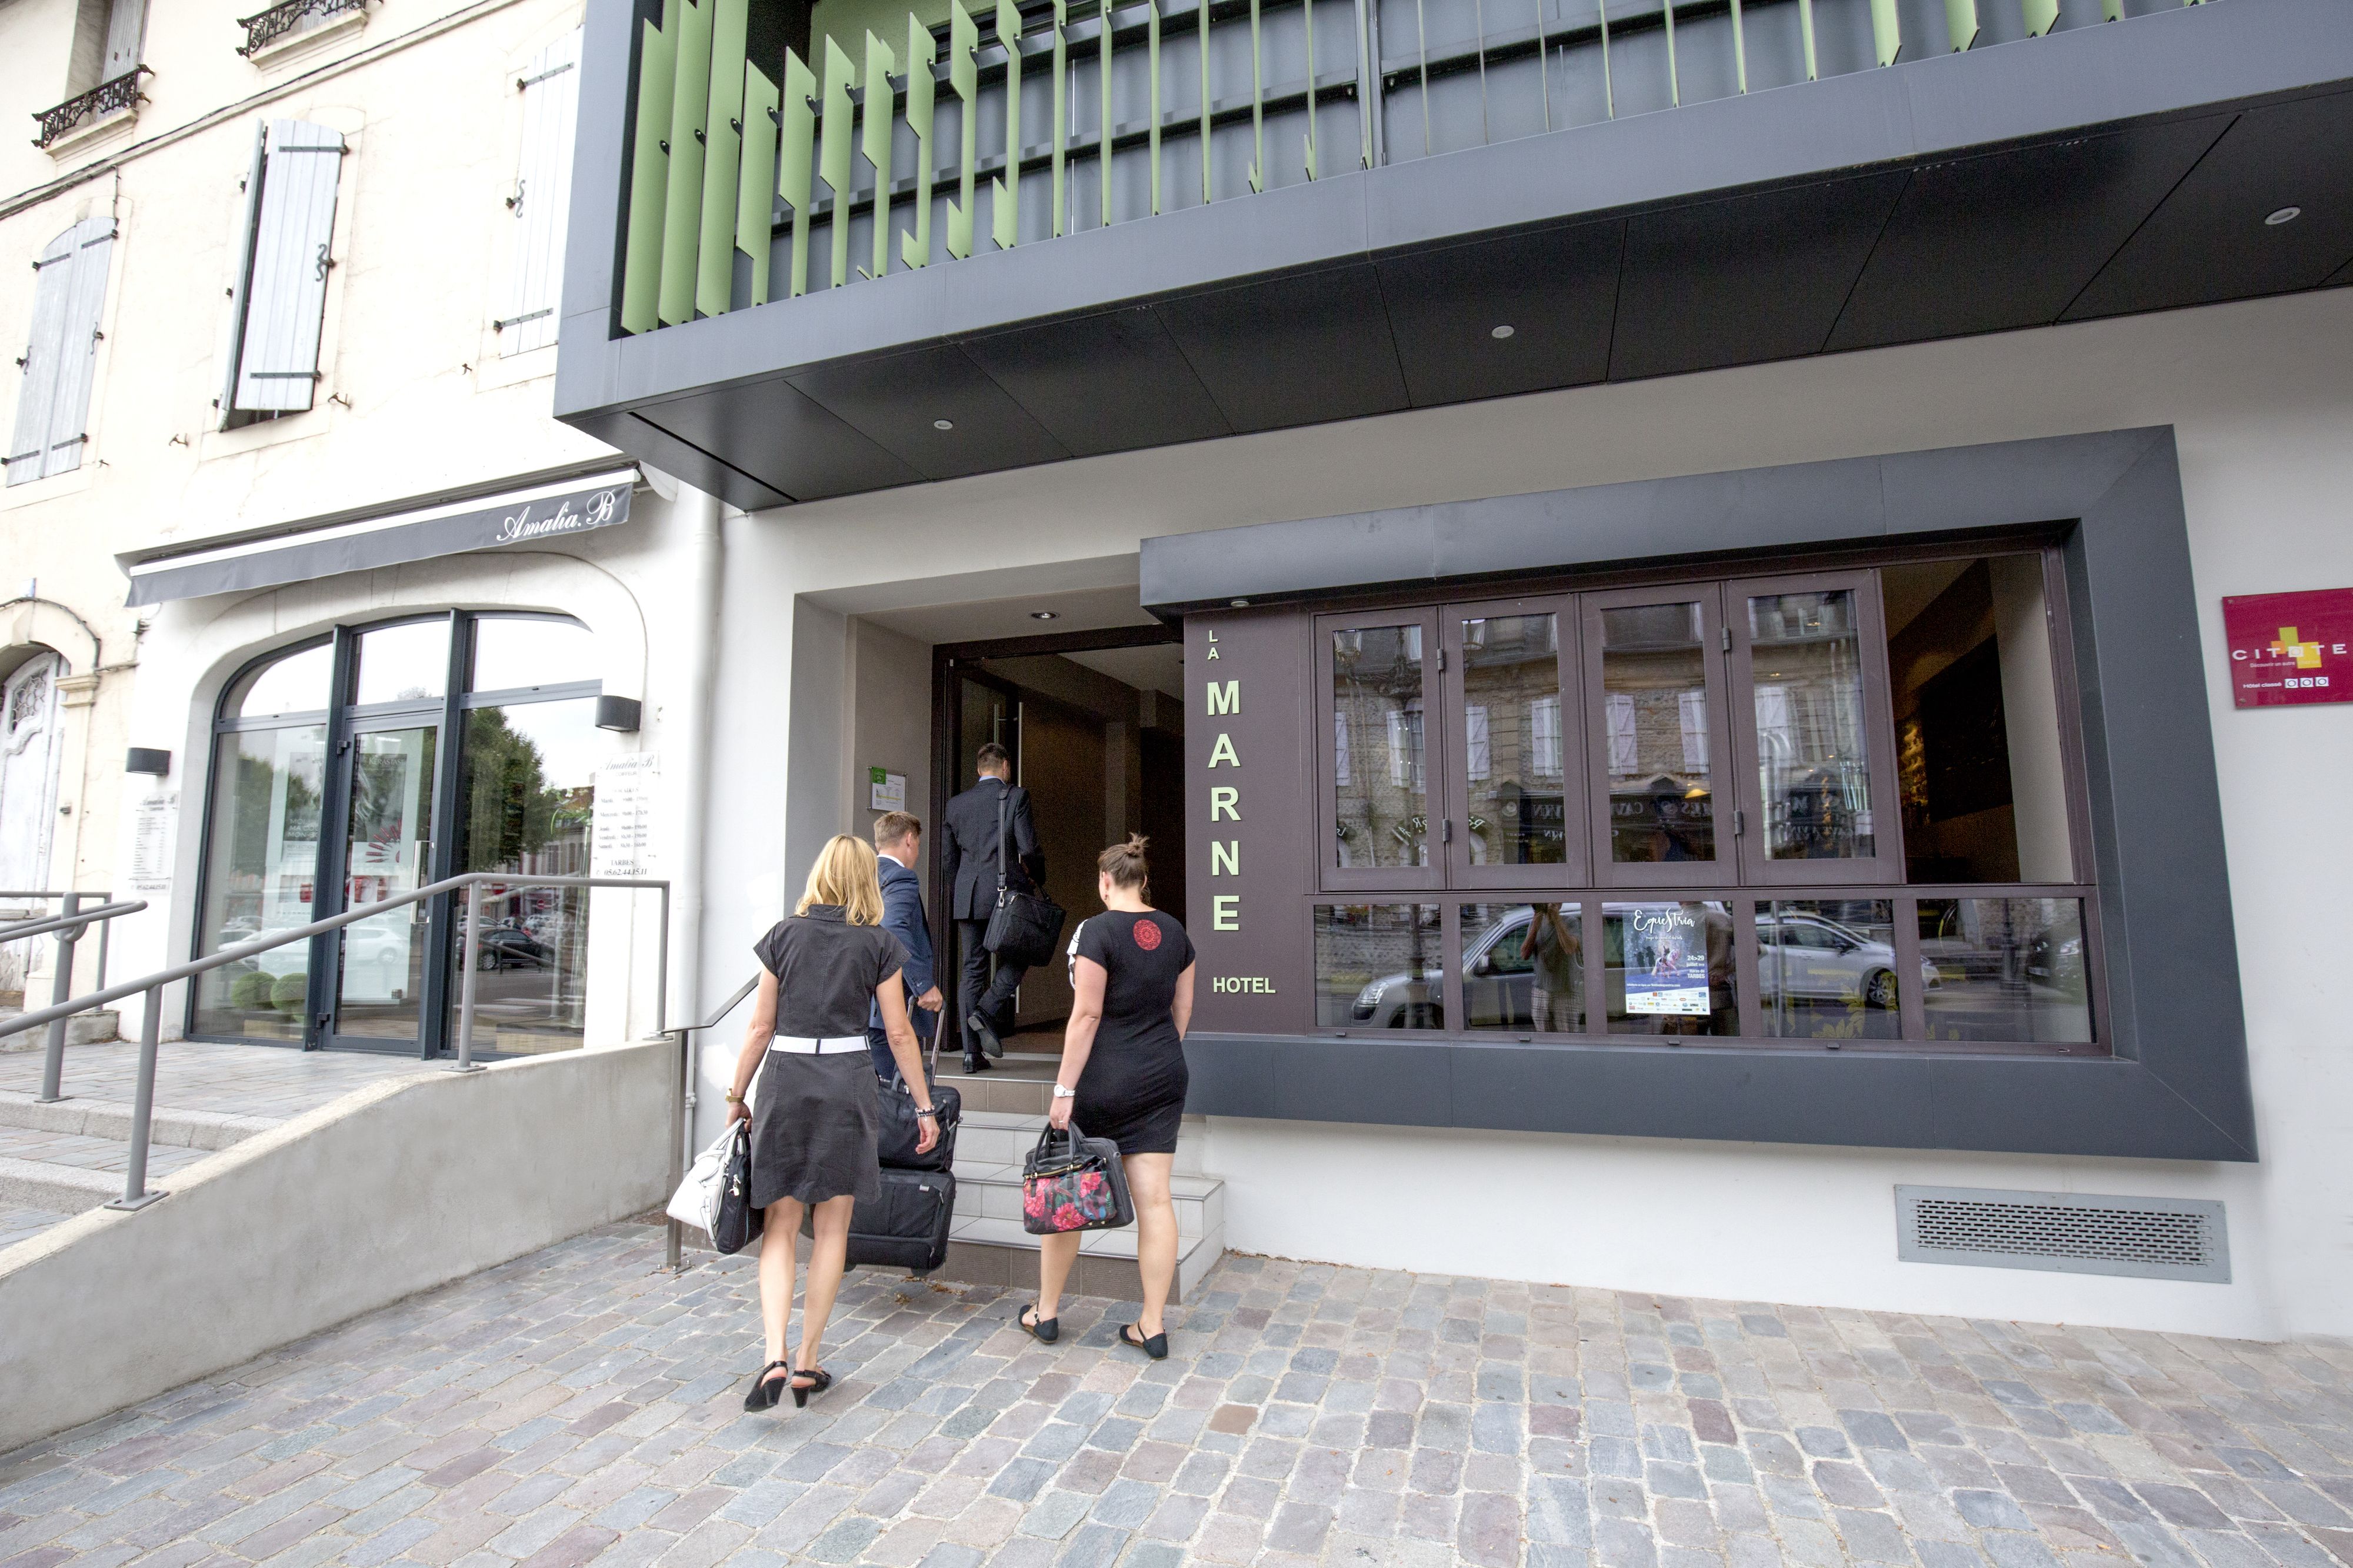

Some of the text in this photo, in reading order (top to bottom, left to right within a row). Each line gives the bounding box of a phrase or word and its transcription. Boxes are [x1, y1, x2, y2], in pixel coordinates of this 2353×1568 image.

[586, 489, 615, 524] B
[1207, 630, 1219, 660] LA
[642, 754, 655, 768] B
[1207, 680, 1241, 931] MARNE
[1212, 977, 1276, 994] HOTEL
